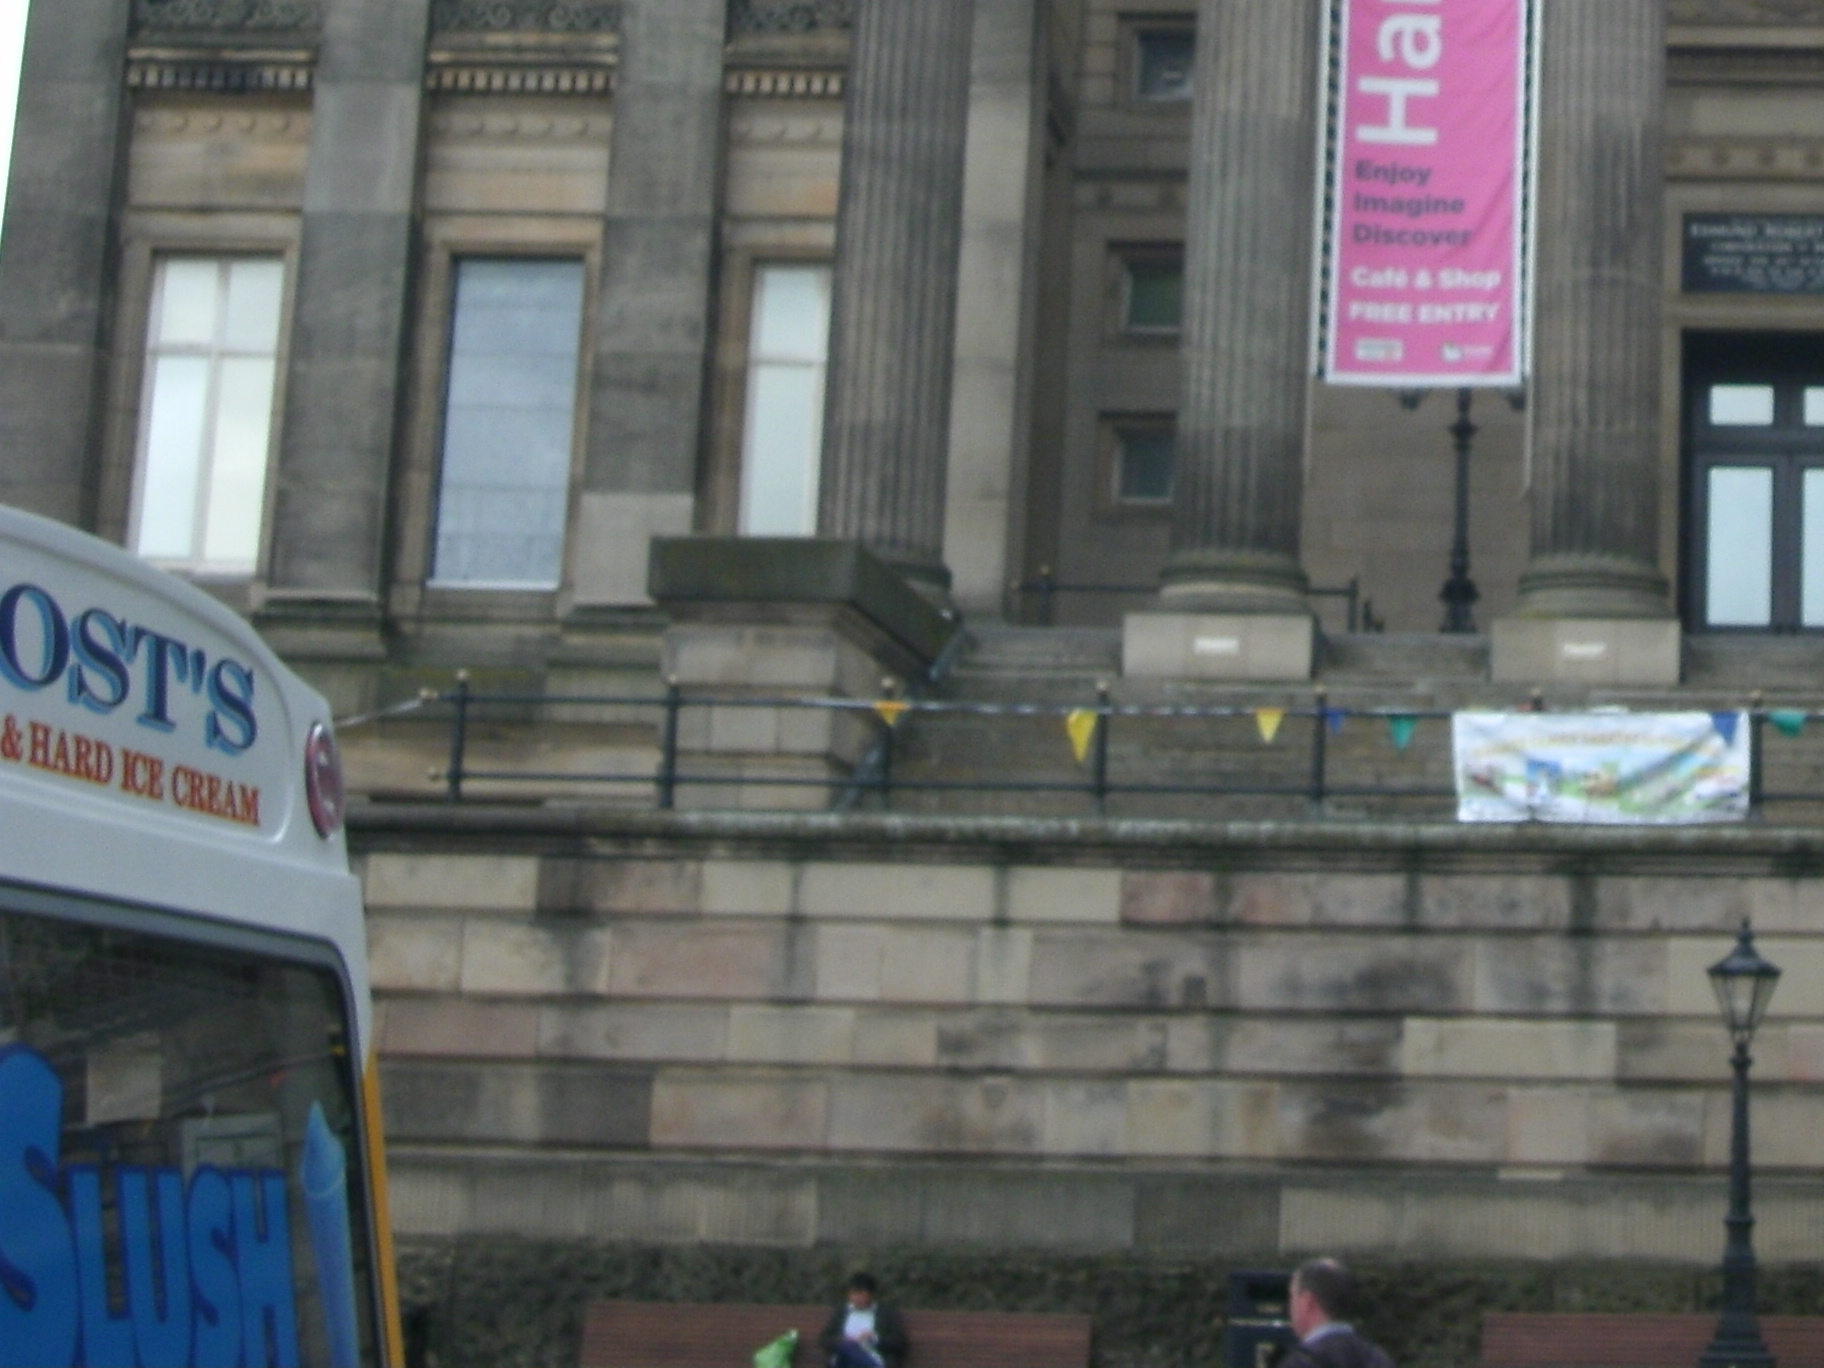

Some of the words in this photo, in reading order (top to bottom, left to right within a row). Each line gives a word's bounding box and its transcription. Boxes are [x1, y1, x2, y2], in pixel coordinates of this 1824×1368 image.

[1354, 159, 1432, 186] Enjoy
[1353, 193, 1466, 217] Imagine
[1352, 223, 1473, 246] Discover
[1439, 268, 1501, 291] Shop
[1349, 301, 1413, 323] FREE
[1418, 302, 1499, 324] ENTRY
[0, 713, 24, 763] &
[28, 719, 114, 786] HARD
[119, 747, 165, 801] ICE
[171, 764, 261, 827] CREAM
